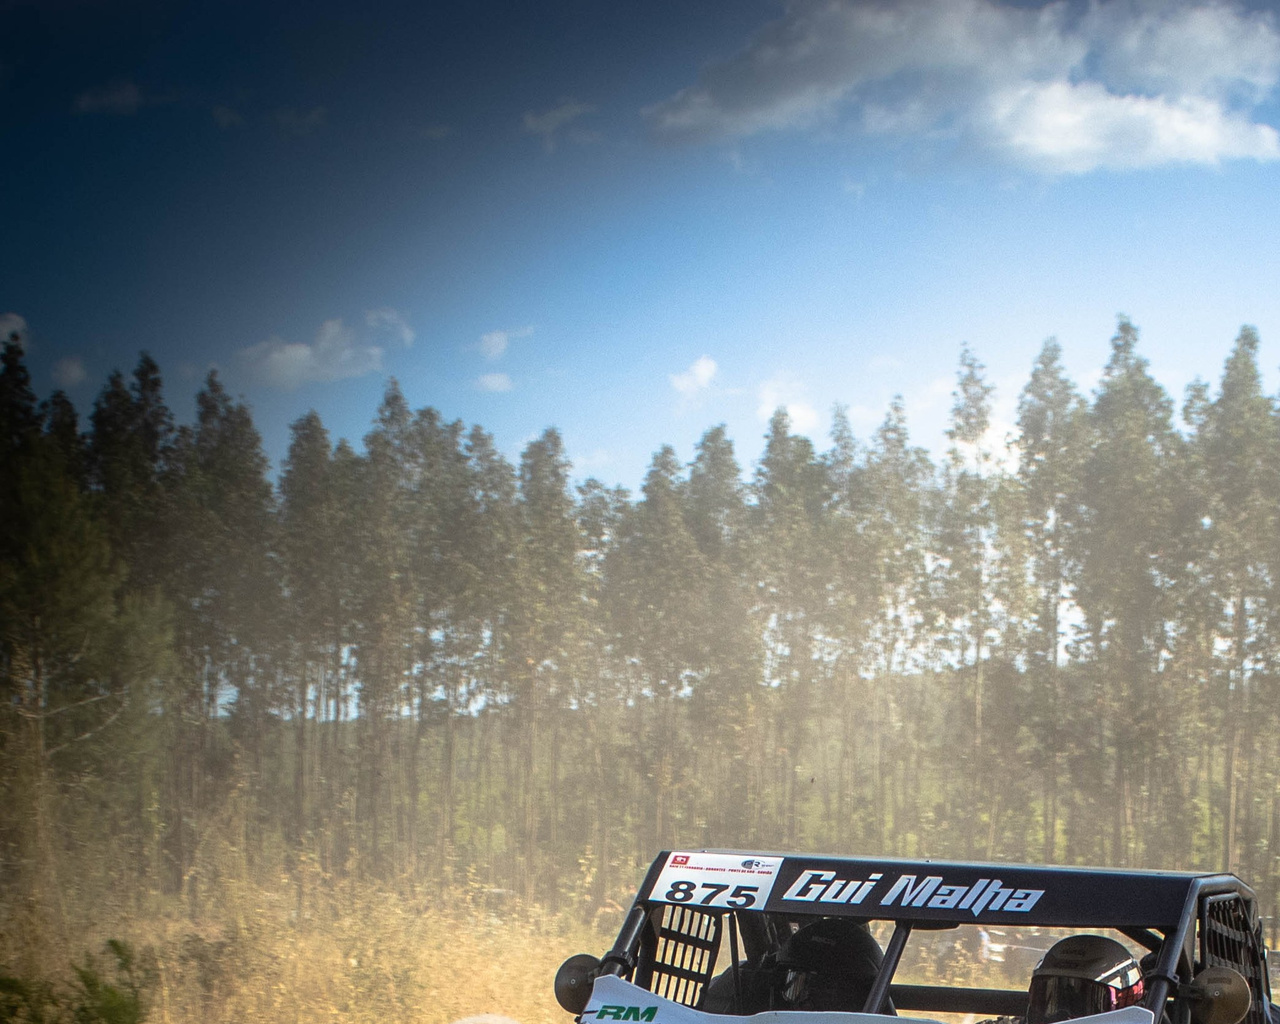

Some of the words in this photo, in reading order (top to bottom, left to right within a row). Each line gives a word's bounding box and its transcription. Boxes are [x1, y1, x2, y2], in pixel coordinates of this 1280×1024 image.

[665, 881, 759, 909] 875
[782, 870, 883, 904] Gui
[880, 875, 1045, 917] Malha
[595, 1005, 658, 1022] RM
